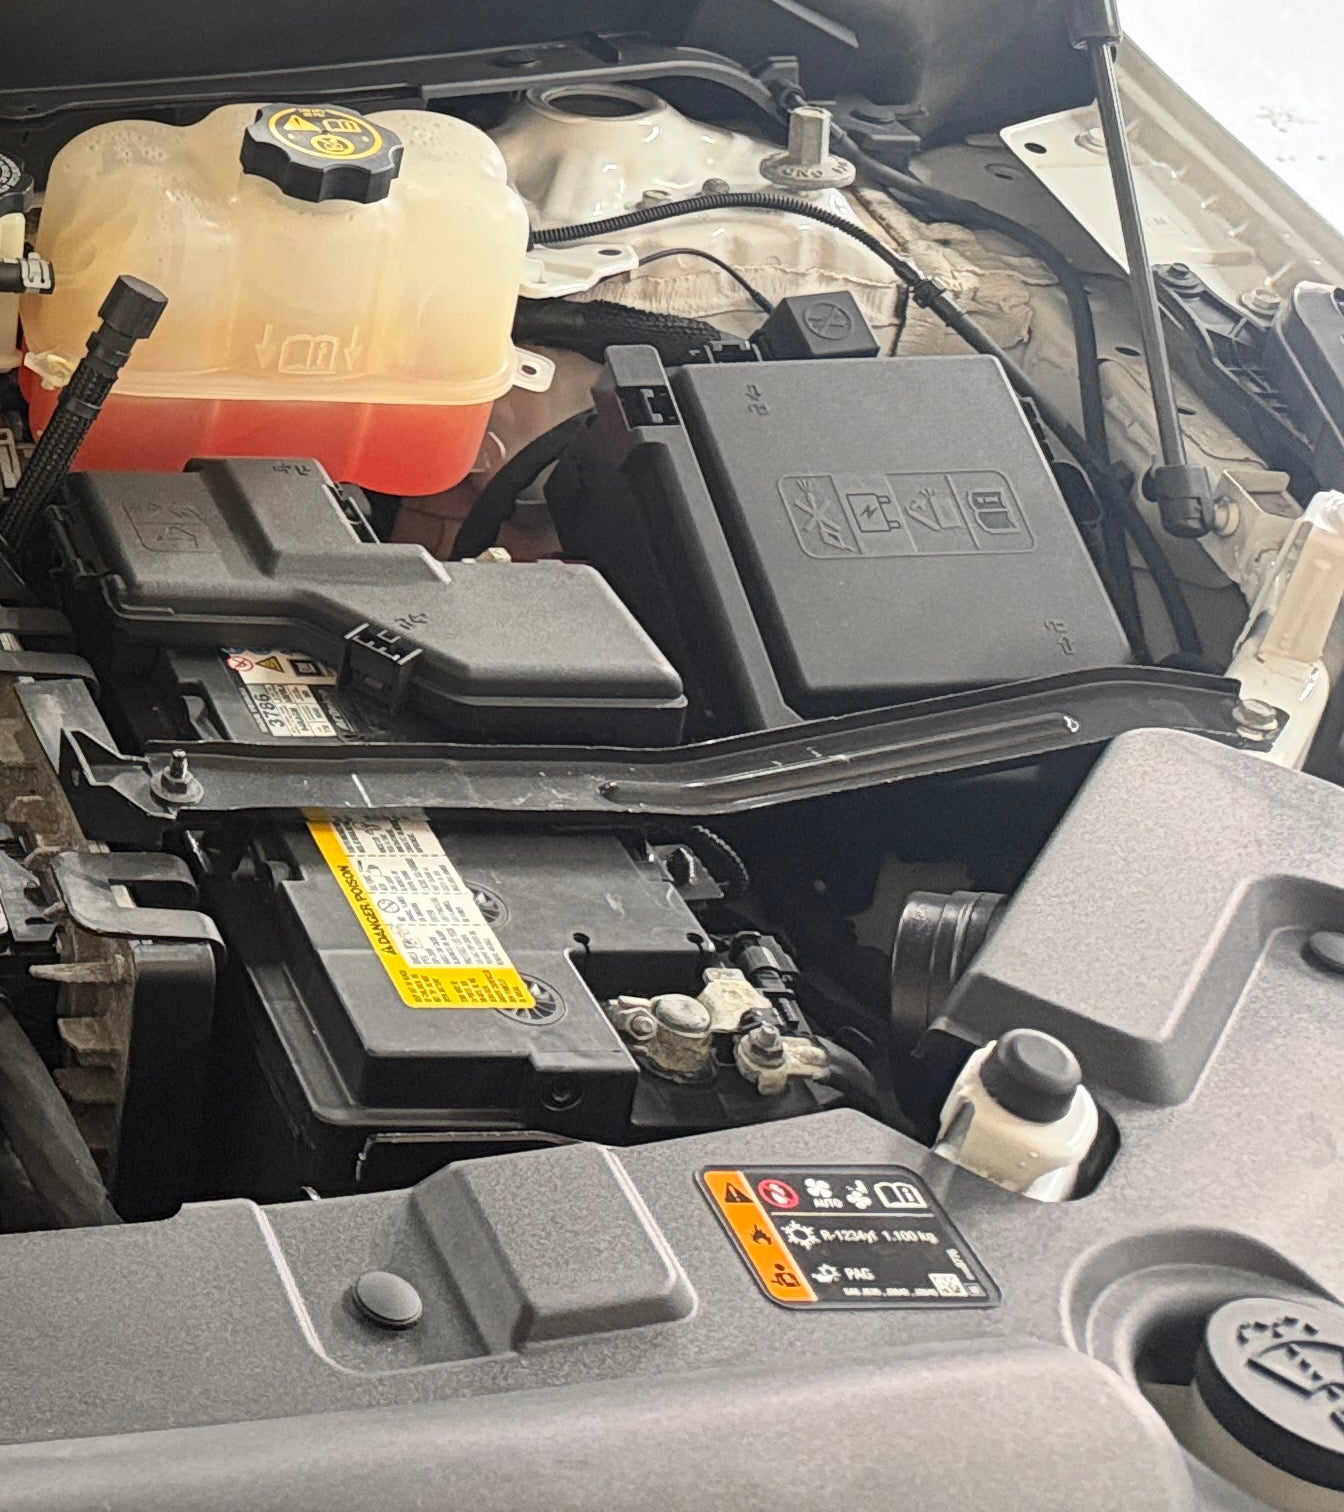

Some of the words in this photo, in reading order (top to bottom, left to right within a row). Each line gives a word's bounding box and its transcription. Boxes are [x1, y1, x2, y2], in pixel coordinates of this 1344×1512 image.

[253, 693, 285, 728] 3786
[336, 864, 368, 903] POISON
[359, 903, 391, 945] DANGER
[812, 1198, 845, 1209] AUTO
[819, 1229, 879, 1244] R-1234yf
[918, 1230, 940, 1245] kg
[843, 1267, 877, 1281] PAG
